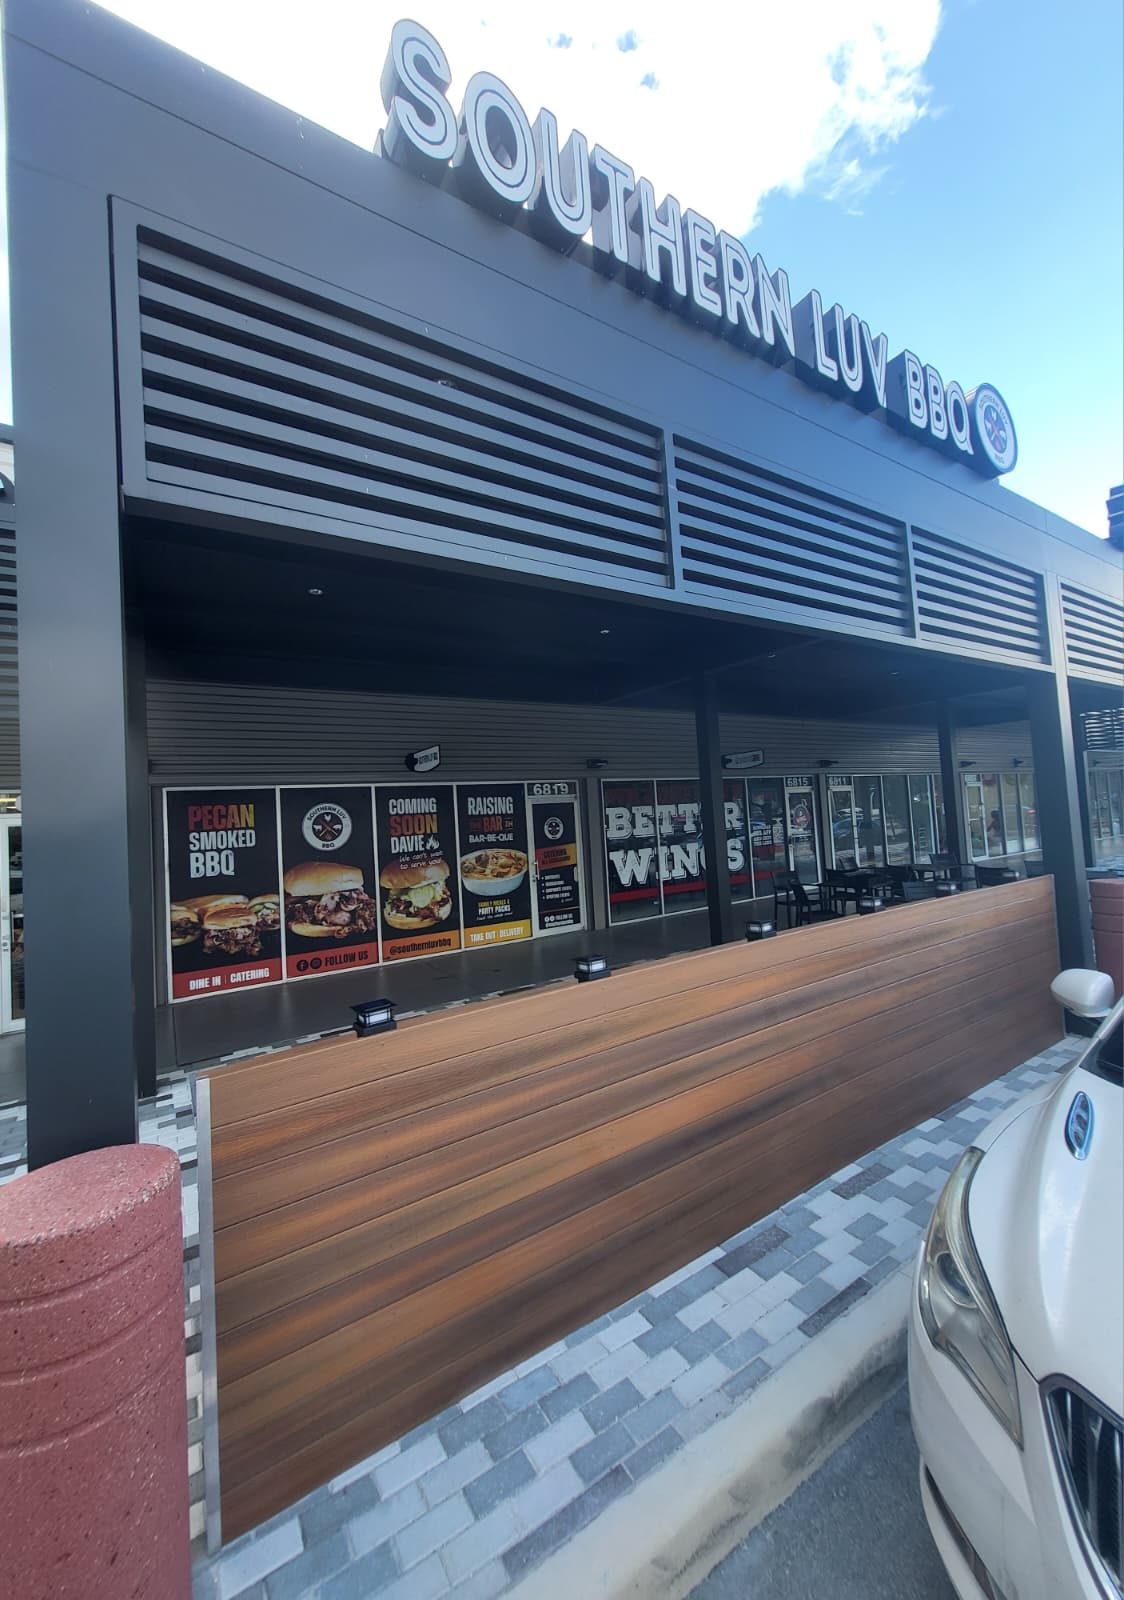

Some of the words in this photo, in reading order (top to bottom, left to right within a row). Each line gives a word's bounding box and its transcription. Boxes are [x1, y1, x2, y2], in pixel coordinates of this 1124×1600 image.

[386, 18, 796, 357] SOUTHERN
[811, 289, 889, 409] LUV
[904, 349, 975, 455] BBQ
[533, 784, 569, 795] 6819
[787, 777, 809, 786] 6815
[307, 806, 337, 820] SOUTHERN
[389, 798, 437, 815] COMING
[467, 796, 514, 816] RAISING
[188, 804, 255, 830] PECAN
[389, 815, 438, 836] SOON
[483, 816, 503, 832] BAR
[605, 801, 742, 840] BETTR
[189, 829, 256, 850] SMOKED
[391, 835, 425, 854] DAVIE
[468, 833, 514, 843] BAR-BE-QUE
[190, 850, 235, 878] BBQ
[608, 839, 745, 887] WINS
[390, 938, 452, 955] @southernluvbbq
[470, 932, 485, 942] TAKE
[324, 953, 357, 967] FOLLOW
[358, 950, 369, 961] US
[189, 977, 210, 991] DINE
[212, 975, 222, 986] IN
[230, 967, 270, 984] CATERING
